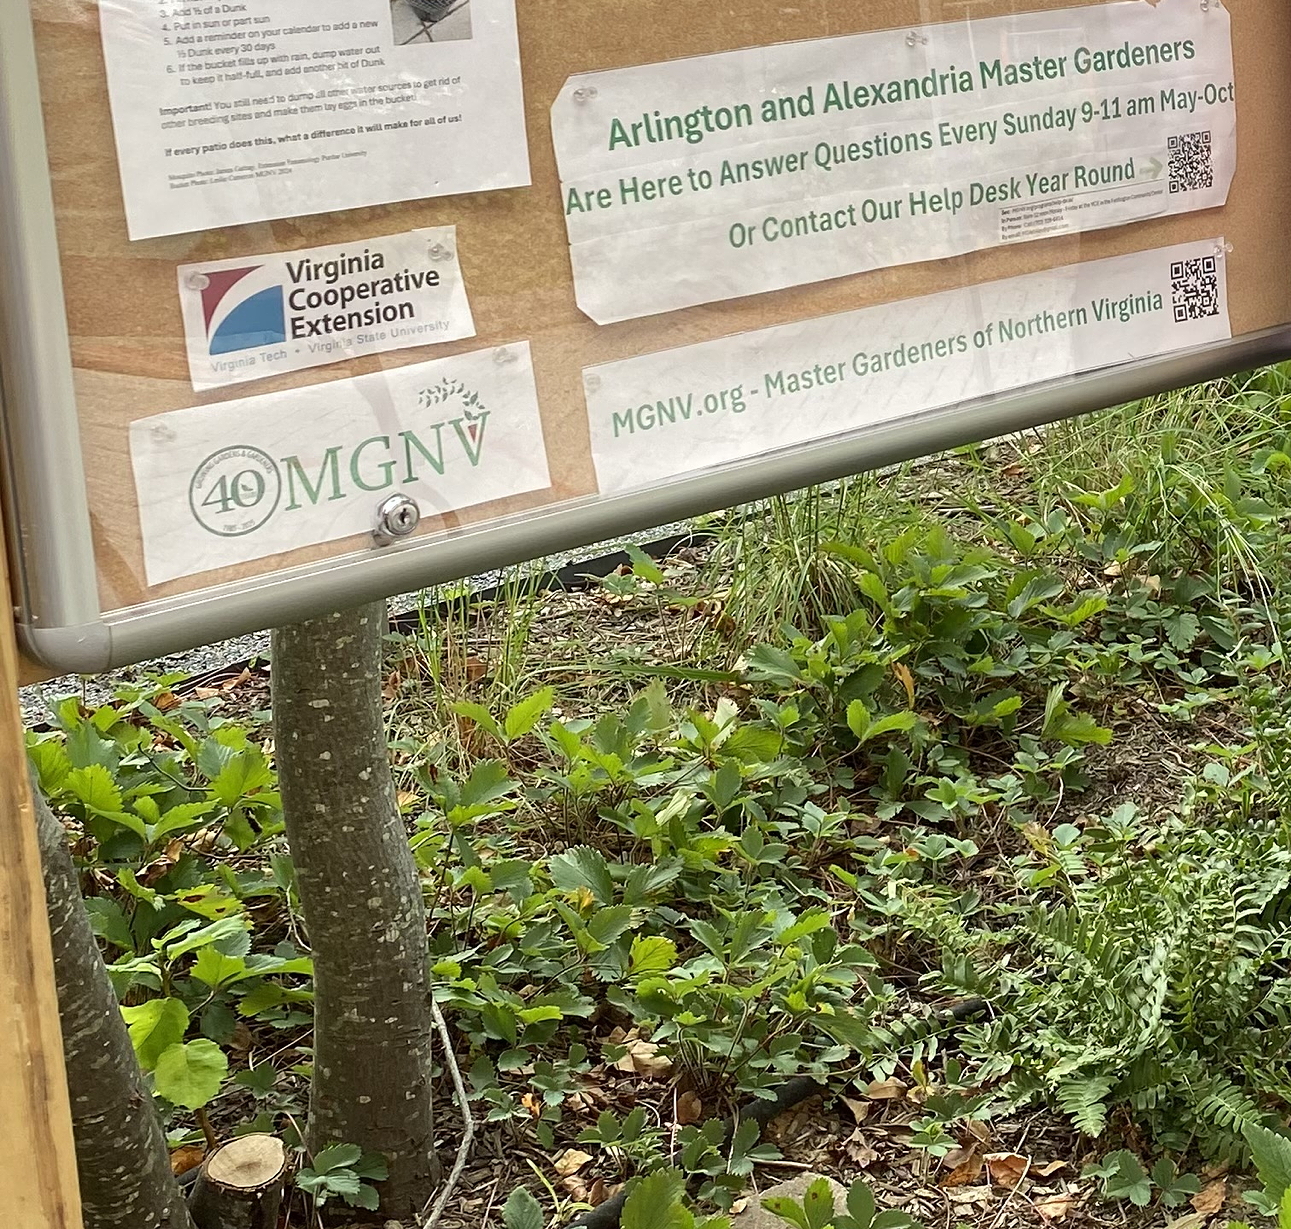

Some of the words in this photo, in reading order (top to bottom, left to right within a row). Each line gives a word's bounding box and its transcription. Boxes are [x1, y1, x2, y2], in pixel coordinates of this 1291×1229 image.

[609, 104, 752, 151] Arlington
[762, 86, 815, 122] and
[823, 65, 973, 113] Alexandria
[979, 56, 1067, 89] Master
[1074, 40, 1195, 74] Gardeners
[165, 148, 172, 156] If
[174, 147, 200, 155] every
[202, 142, 227, 154] patio
[229, 141, 253, 149] does
[254, 137, 276, 145] this,
[277, 134, 301, 143] what
[311, 128, 355, 139] difference
[365, 124, 383, 132] will
[384, 121, 408, 130] make
[424, 117, 436, 125] all
[437, 116, 446, 124] of
[448, 114, 462, 123] us!
[566, 188, 612, 215] Are
[619, 176, 683, 204] Here
[687, 169, 712, 191] to
[720, 151, 808, 186] Answer
[815, 131, 932, 171] Questions
[939, 120, 997, 146] Every
[1003, 106, 1077, 135] Sunday
[1082, 97, 1121, 123] 9-11
[1127, 97, 1154, 116] am
[1161, 82, 1234, 113] May-Oct
[729, 223, 756, 248] Or
[762, 205, 856, 241] Contact
[862, 199, 902, 221] Our
[909, 188, 963, 215] Help
[970, 177, 1021, 206] Desk
[1026, 173, 1069, 197] Year
[1075, 157, 1136, 188] Round
[286, 248, 384, 285] Virginia
[288, 268, 440, 312] Cooperative
[211, 356, 256, 372] Virginia
[260, 349, 287, 362] Tech
[308, 339, 352, 353] Virginia
[357, 332, 386, 344] State
[391, 321, 449, 337] University
[291, 300, 415, 339] Extension
[612, 385, 746, 437] MGNV.org
[765, 362, 846, 398] Master
[853, 335, 967, 376] Gardeners
[973, 323, 993, 348] of
[999, 308, 1087, 343] Northern
[1092, 291, 1162, 322] Virginia
[202, 470, 265, 514] 40
[280, 411, 491, 510] MGNV
